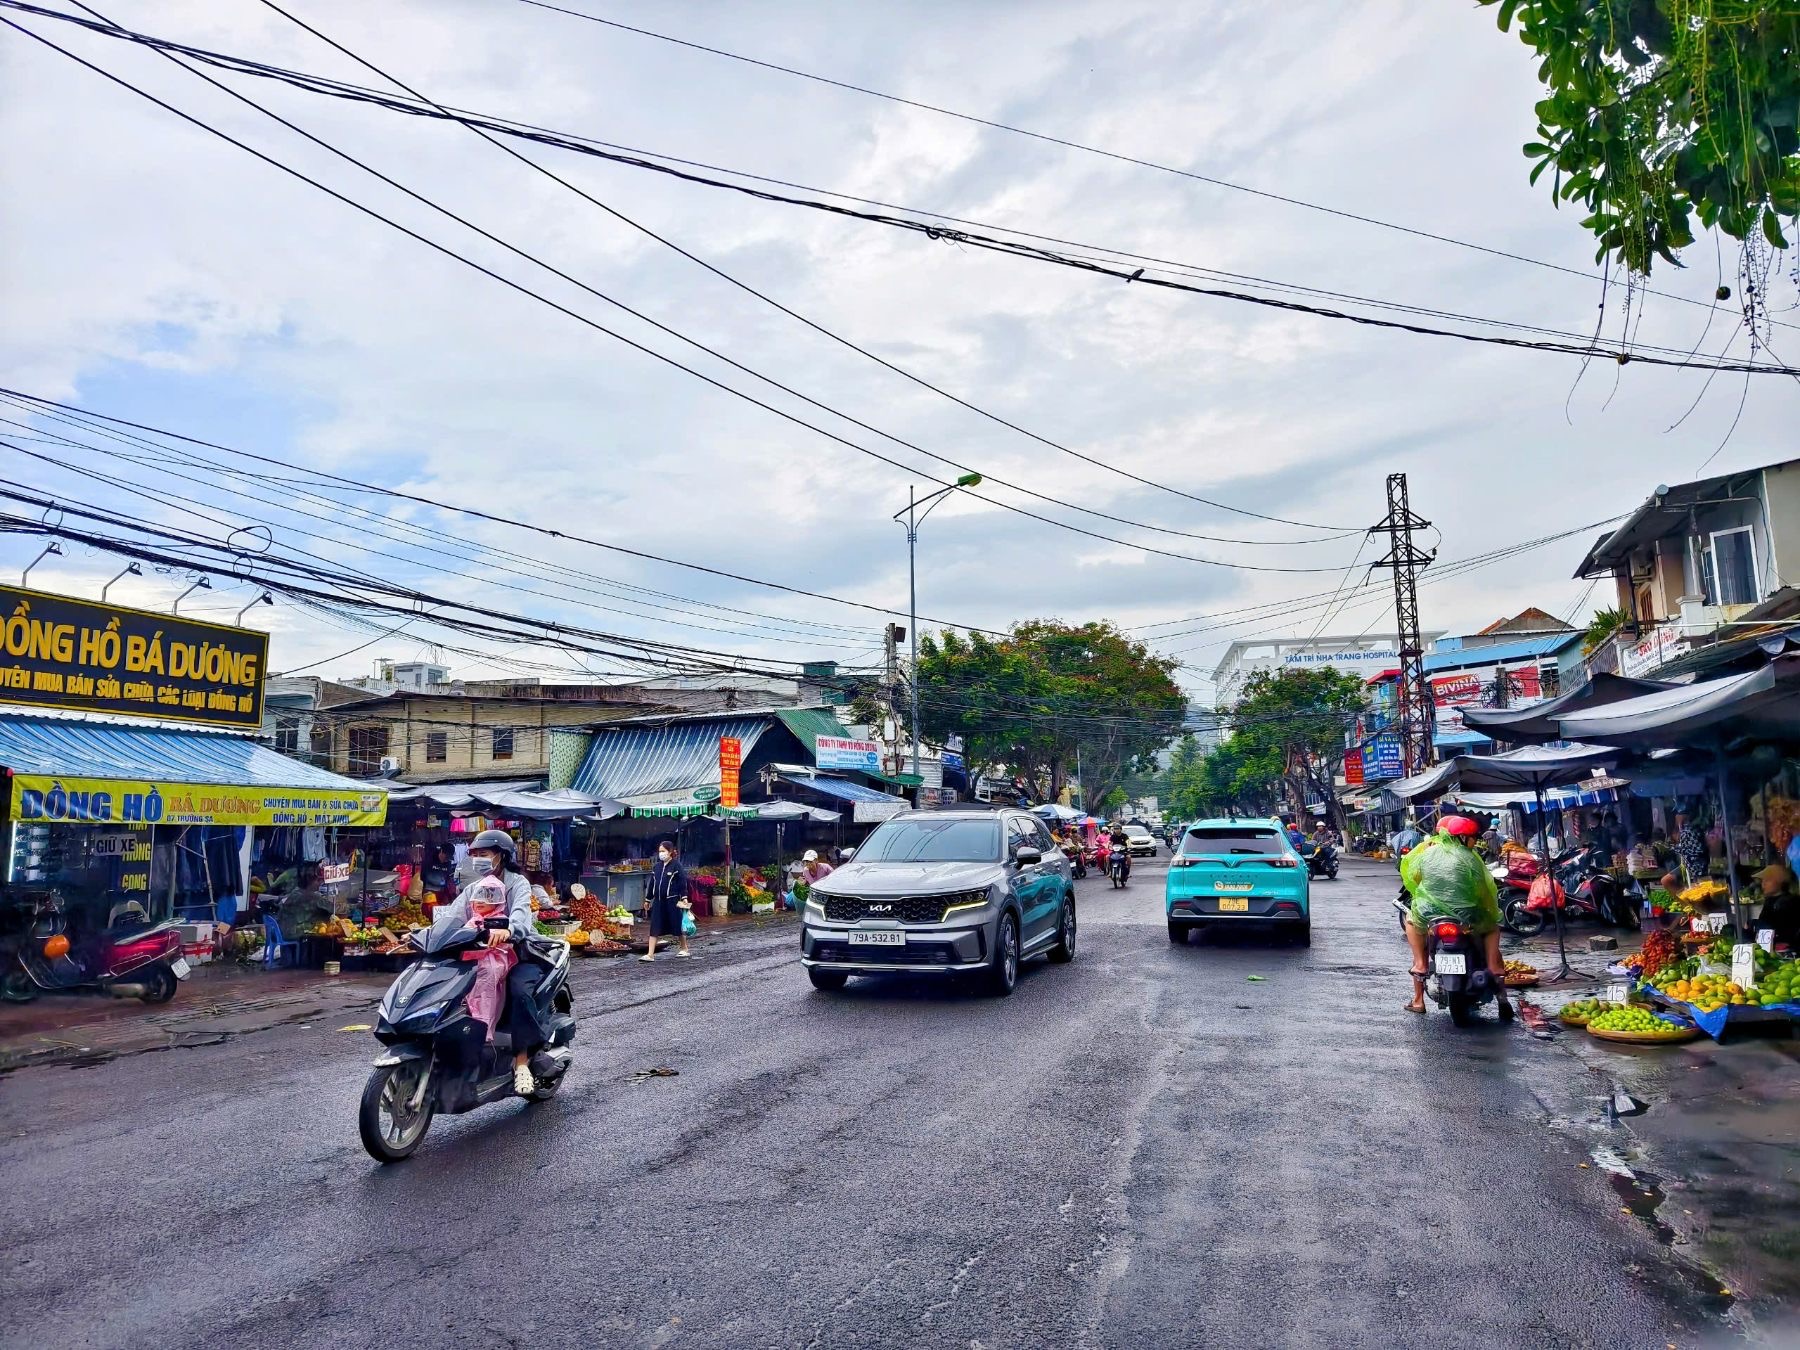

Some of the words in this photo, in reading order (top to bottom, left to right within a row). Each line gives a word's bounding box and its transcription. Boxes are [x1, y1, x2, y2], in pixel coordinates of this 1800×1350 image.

[0, 600, 75, 663] ỒNG
[79, 616, 121, 669] HỒ
[125, 631, 165, 675] BÁ
[168, 641, 257, 687] DƯƠNG
[1335, 653, 1361, 661] TRANG
[1363, 651, 1397, 660] HOSPITAL
[33, 671, 63, 693] MUA
[66, 673, 94, 696] BÁN
[1436, 675, 1478, 696] BIVINA
[20, 780, 113, 821] ĐỒNG
[122, 784, 164, 822] HỒ
[199, 796, 261, 814] DƯƠNG
[292, 799, 305, 810] MUA
[322, 800, 328, 810] &
[96, 836, 117, 853] GIỮ
[120, 838, 136, 852] XE
[869, 904, 892, 912] KIA
